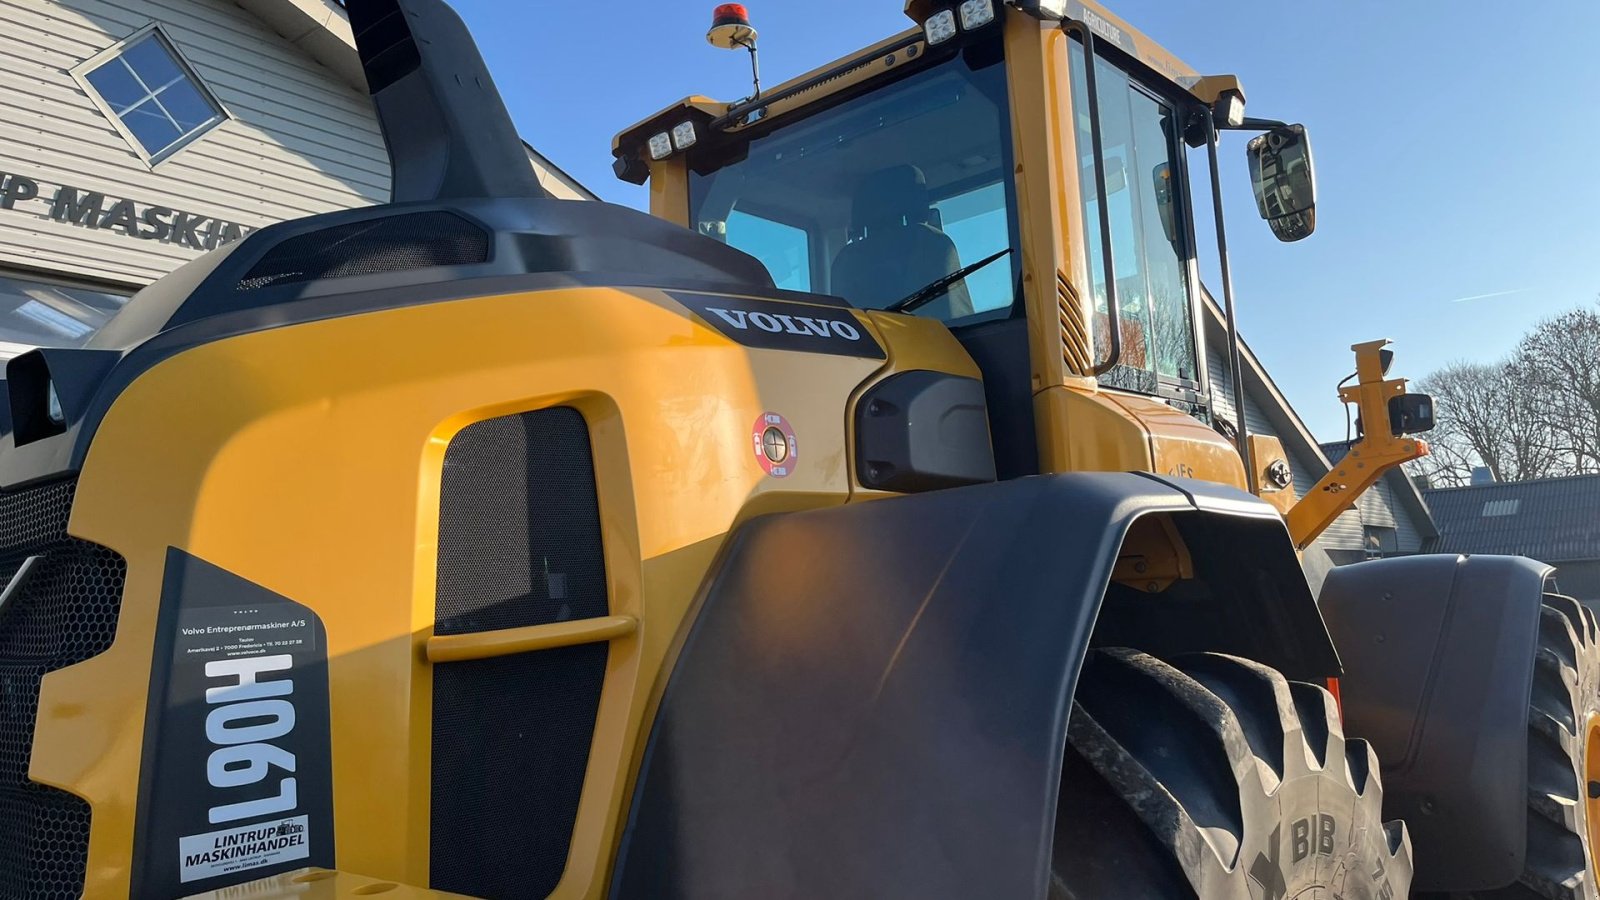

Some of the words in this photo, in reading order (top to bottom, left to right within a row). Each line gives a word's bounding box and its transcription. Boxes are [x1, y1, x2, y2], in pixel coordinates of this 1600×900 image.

[1083, 7, 1121, 44] AGRICULTURE
[705, 306, 861, 341] VOLVO
[291, 619, 306, 627] A/S
[205, 654, 297, 824] L90H
[185, 834, 305, 868] MASKINHANDEL
[214, 827, 276, 849] LINTRUP
[223, 858, 268, 872] www.limas.dk
